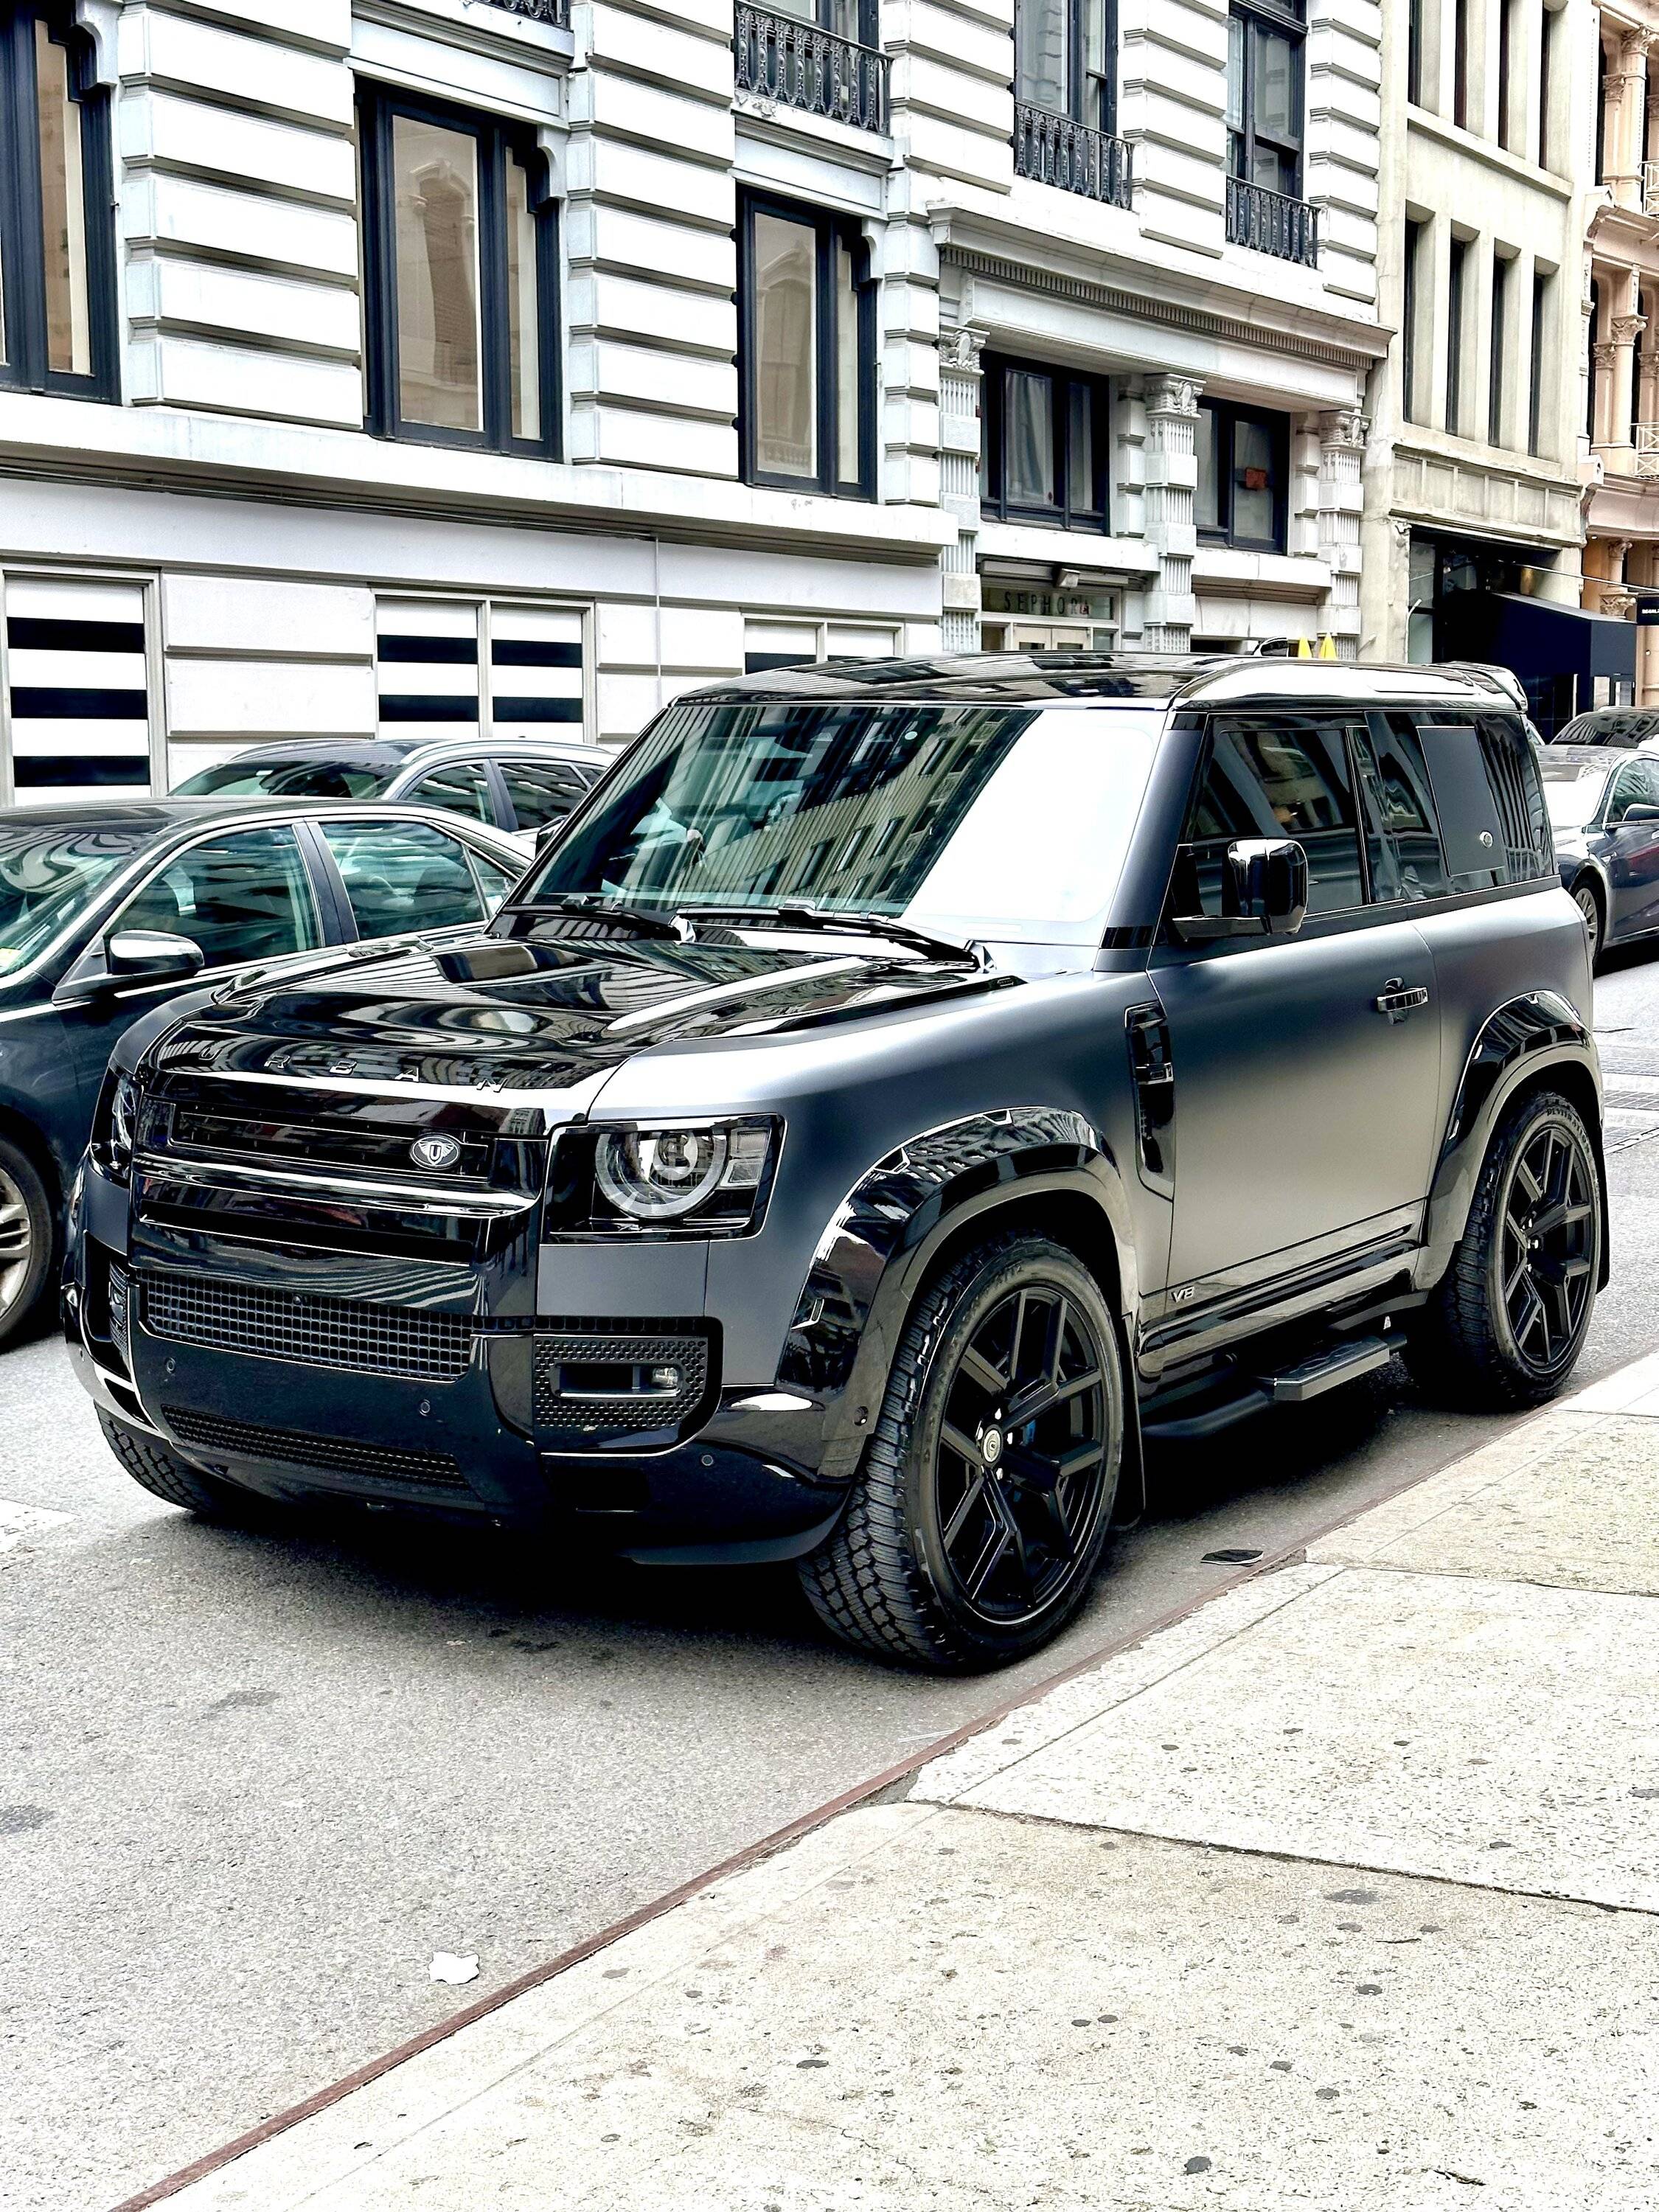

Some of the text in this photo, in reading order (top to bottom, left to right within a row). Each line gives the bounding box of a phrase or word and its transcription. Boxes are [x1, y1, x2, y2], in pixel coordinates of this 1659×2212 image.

[1004, 591, 1090, 615] SEPHORA
[198, 1046, 509, 1093] URBAN
[1171, 1286, 1195, 1303] V8
